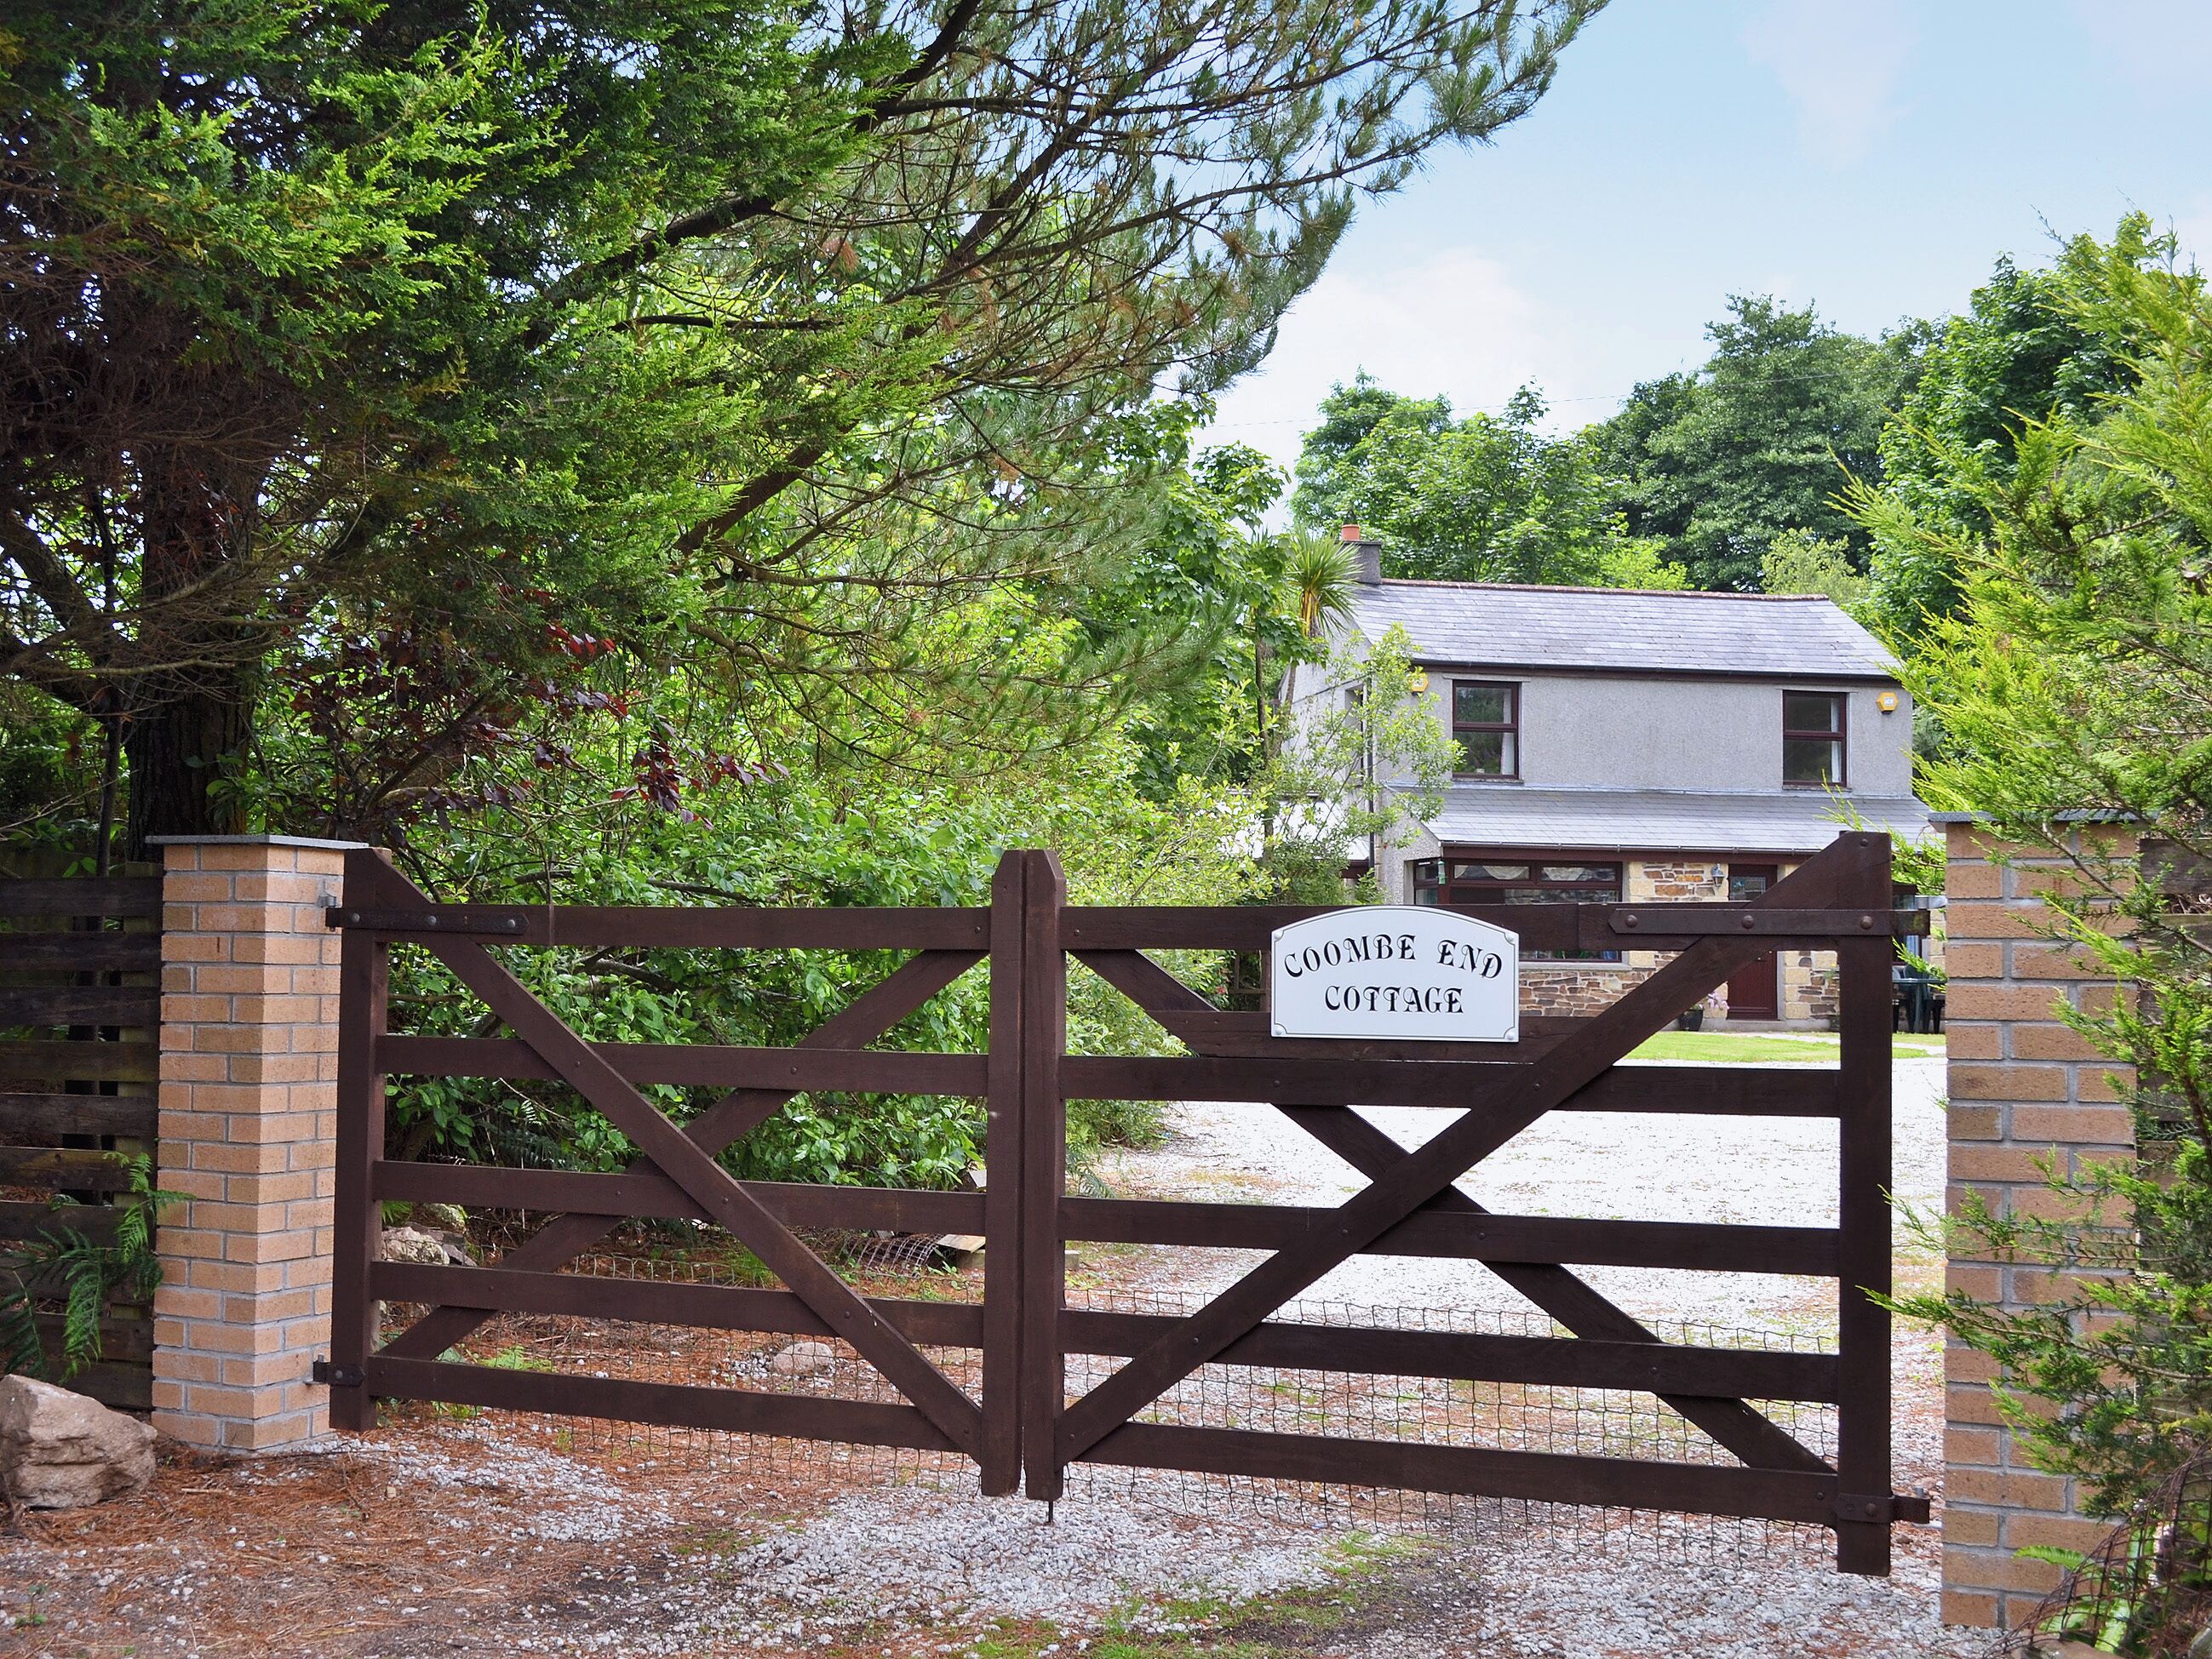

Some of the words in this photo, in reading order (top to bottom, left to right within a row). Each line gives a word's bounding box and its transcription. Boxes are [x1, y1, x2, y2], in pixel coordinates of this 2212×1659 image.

[1284, 934, 1416, 979] COOMBE
[1437, 939, 1503, 979] END
[1325, 986, 1464, 1014] COTTAGE
